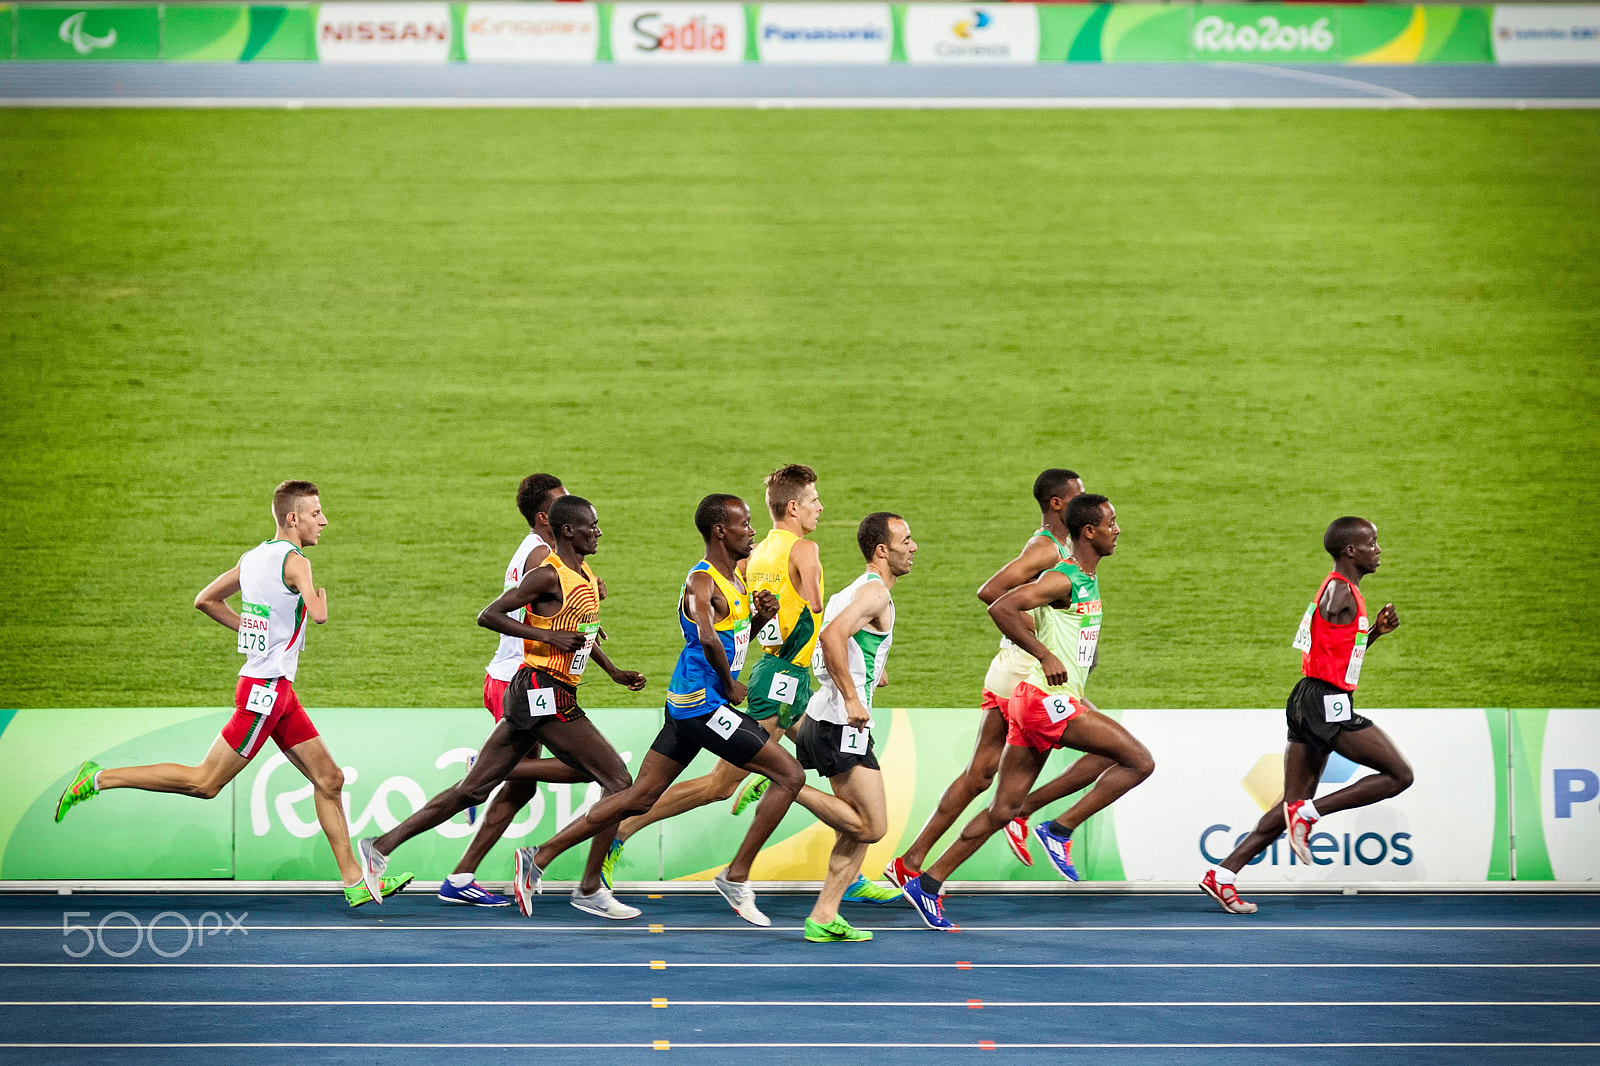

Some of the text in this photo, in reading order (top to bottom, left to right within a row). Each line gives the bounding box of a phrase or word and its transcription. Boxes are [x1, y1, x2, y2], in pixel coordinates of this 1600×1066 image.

[322, 21, 446, 42] NISSAN
[632, 12, 725, 51] Sadia
[1194, 15, 1333, 51] Rio2016
[747, 572, 781, 583] USTRALIA
[776, 681, 788, 697] 2
[250, 690, 273, 708] 10
[535, 694, 547, 710] 4
[1053, 699, 1066, 714] 8
[1333, 701, 1343, 717] 9
[717, 716, 732, 731] 5
[848, 733, 858, 749] 1
